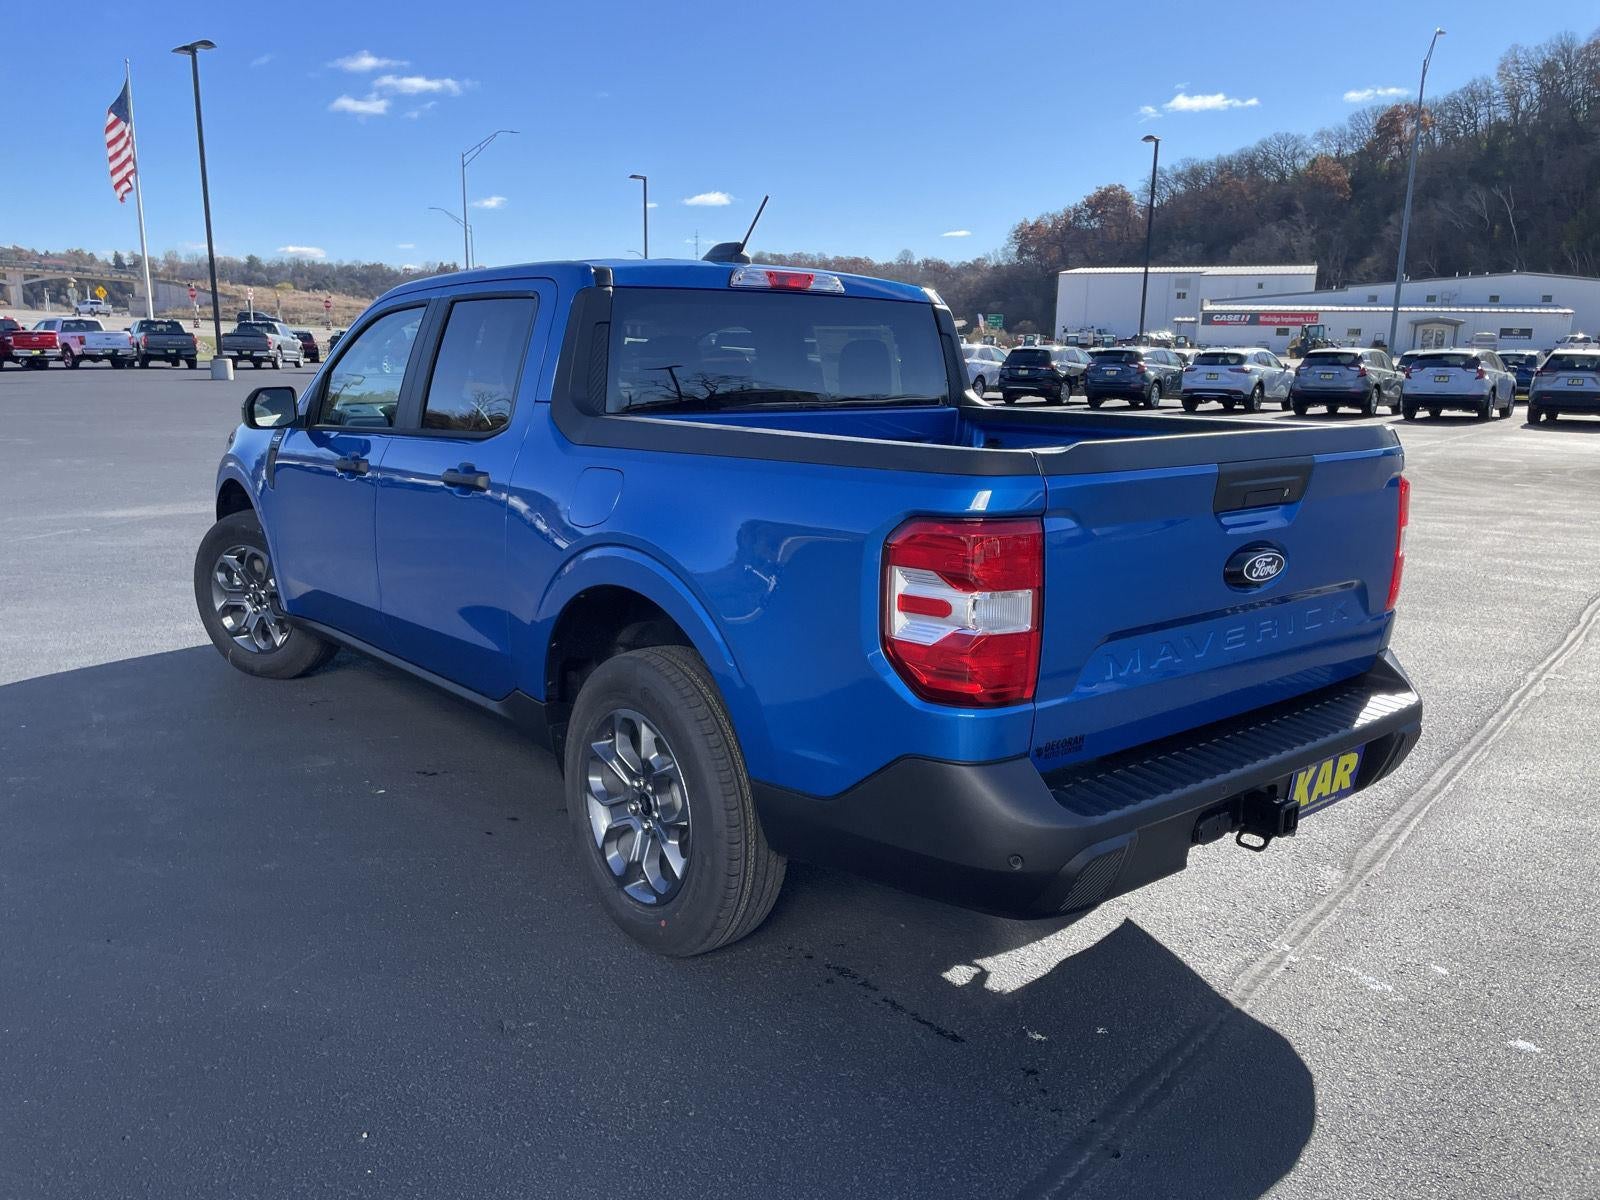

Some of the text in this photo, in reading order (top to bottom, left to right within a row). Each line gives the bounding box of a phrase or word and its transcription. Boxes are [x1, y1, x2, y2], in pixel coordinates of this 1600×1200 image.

[1212, 314, 1239, 322] CASE
[1252, 557, 1279, 578] Ford
[1103, 600, 1349, 681] MAVERICK
[1044, 734, 1086, 752] DECORAH
[1293, 752, 1359, 807] KAR
